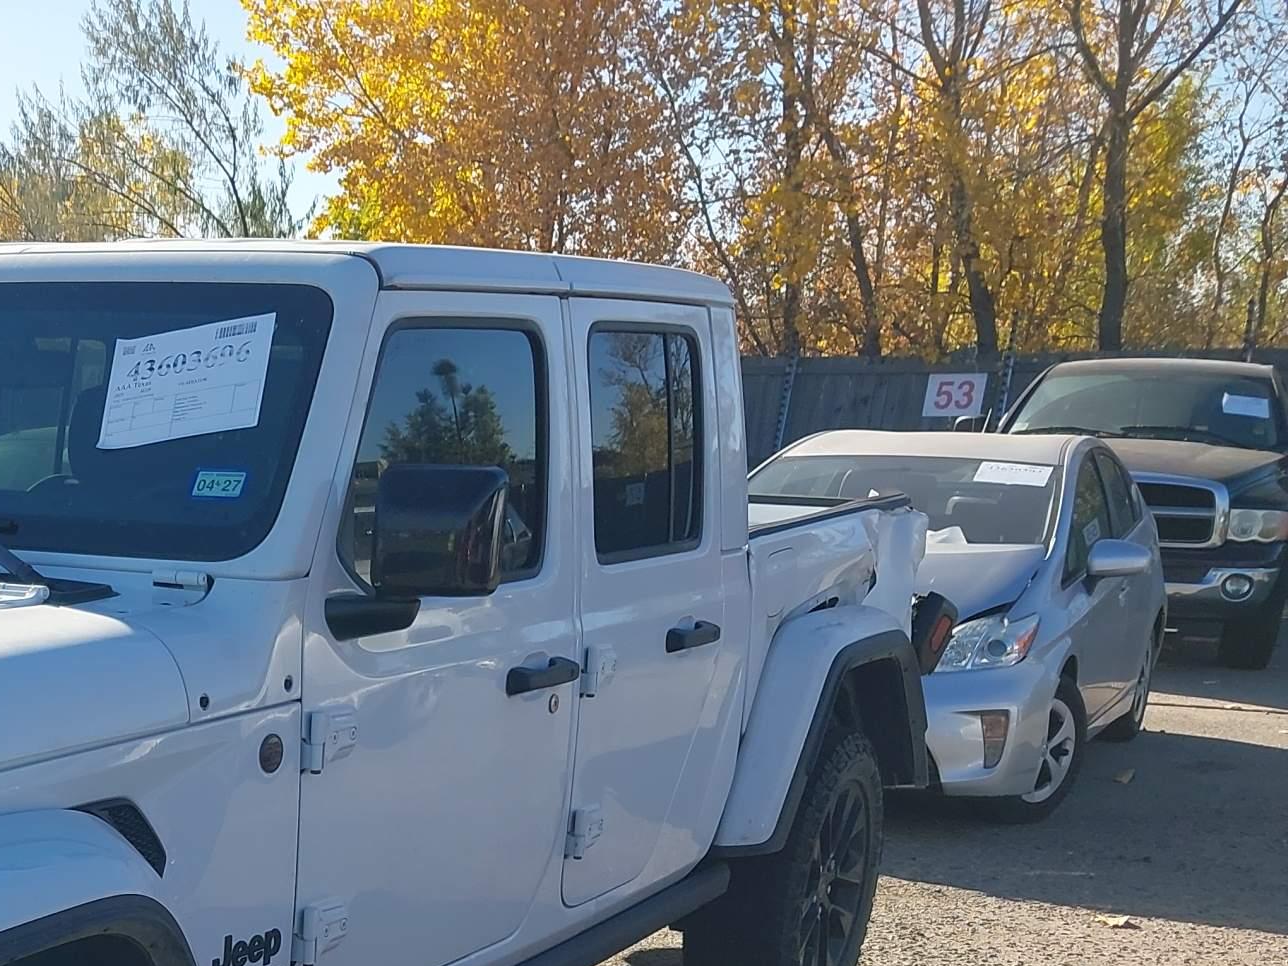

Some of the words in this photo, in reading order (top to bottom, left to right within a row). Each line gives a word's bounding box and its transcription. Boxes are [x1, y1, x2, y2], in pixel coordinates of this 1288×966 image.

[934, 380, 975, 410] 53
[197, 479, 216, 492] 04
[221, 479, 242, 492] 27
